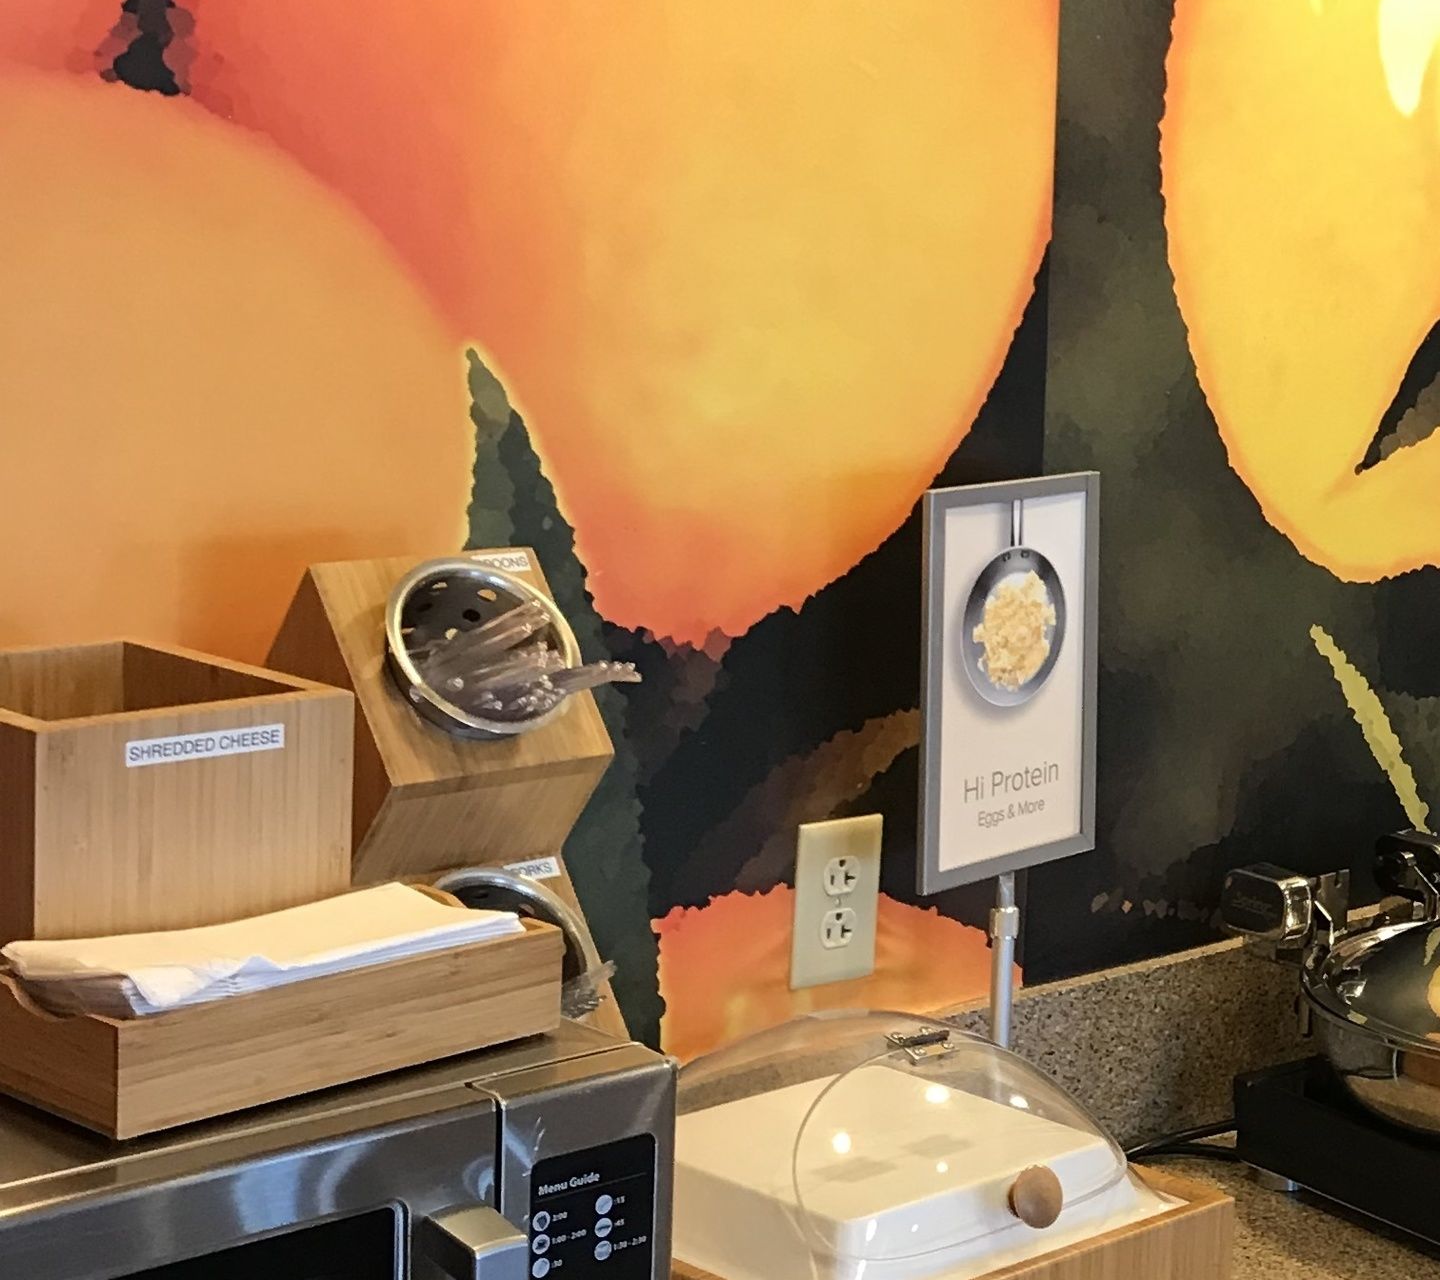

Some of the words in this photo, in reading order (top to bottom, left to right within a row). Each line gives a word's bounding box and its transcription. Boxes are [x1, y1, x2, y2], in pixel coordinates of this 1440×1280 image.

[128, 737, 216, 762] SHREDDED
[219, 728, 281, 751] CHEESE
[963, 775, 985, 804] Hi
[991, 760, 1060, 798] Protein
[977, 808, 1006, 829] Eggs
[1007, 803, 1016, 819] &
[1017, 798, 1046, 817] More
[538, 1181, 568, 1196] Menu
[569, 1171, 601, 1188] Guide
